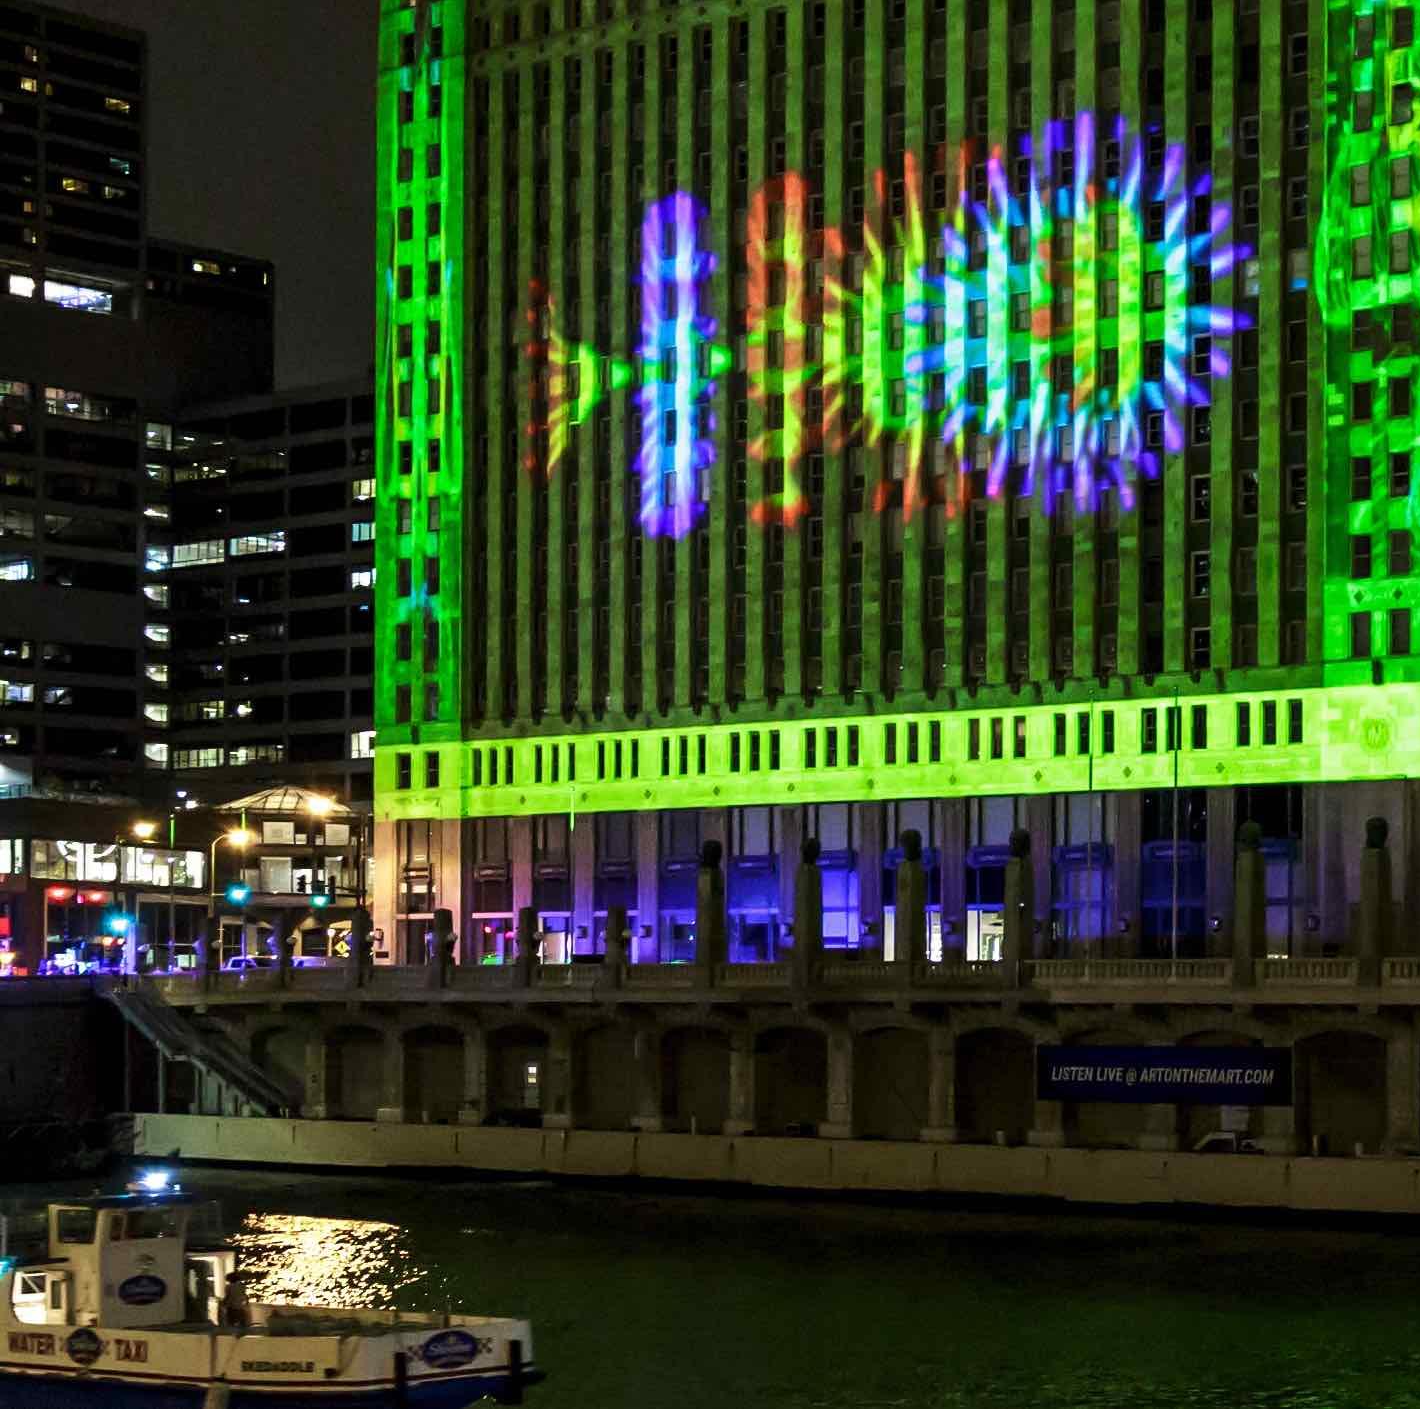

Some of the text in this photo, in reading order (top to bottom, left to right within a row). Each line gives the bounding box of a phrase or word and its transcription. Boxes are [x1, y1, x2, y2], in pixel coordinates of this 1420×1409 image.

[1051, 1066, 1275, 1086] LISTEN LIVE @ ARTONTHEMART.COM
[8, 1332, 55, 1355] WATER
[114, 1339, 148, 1362] TAXI
